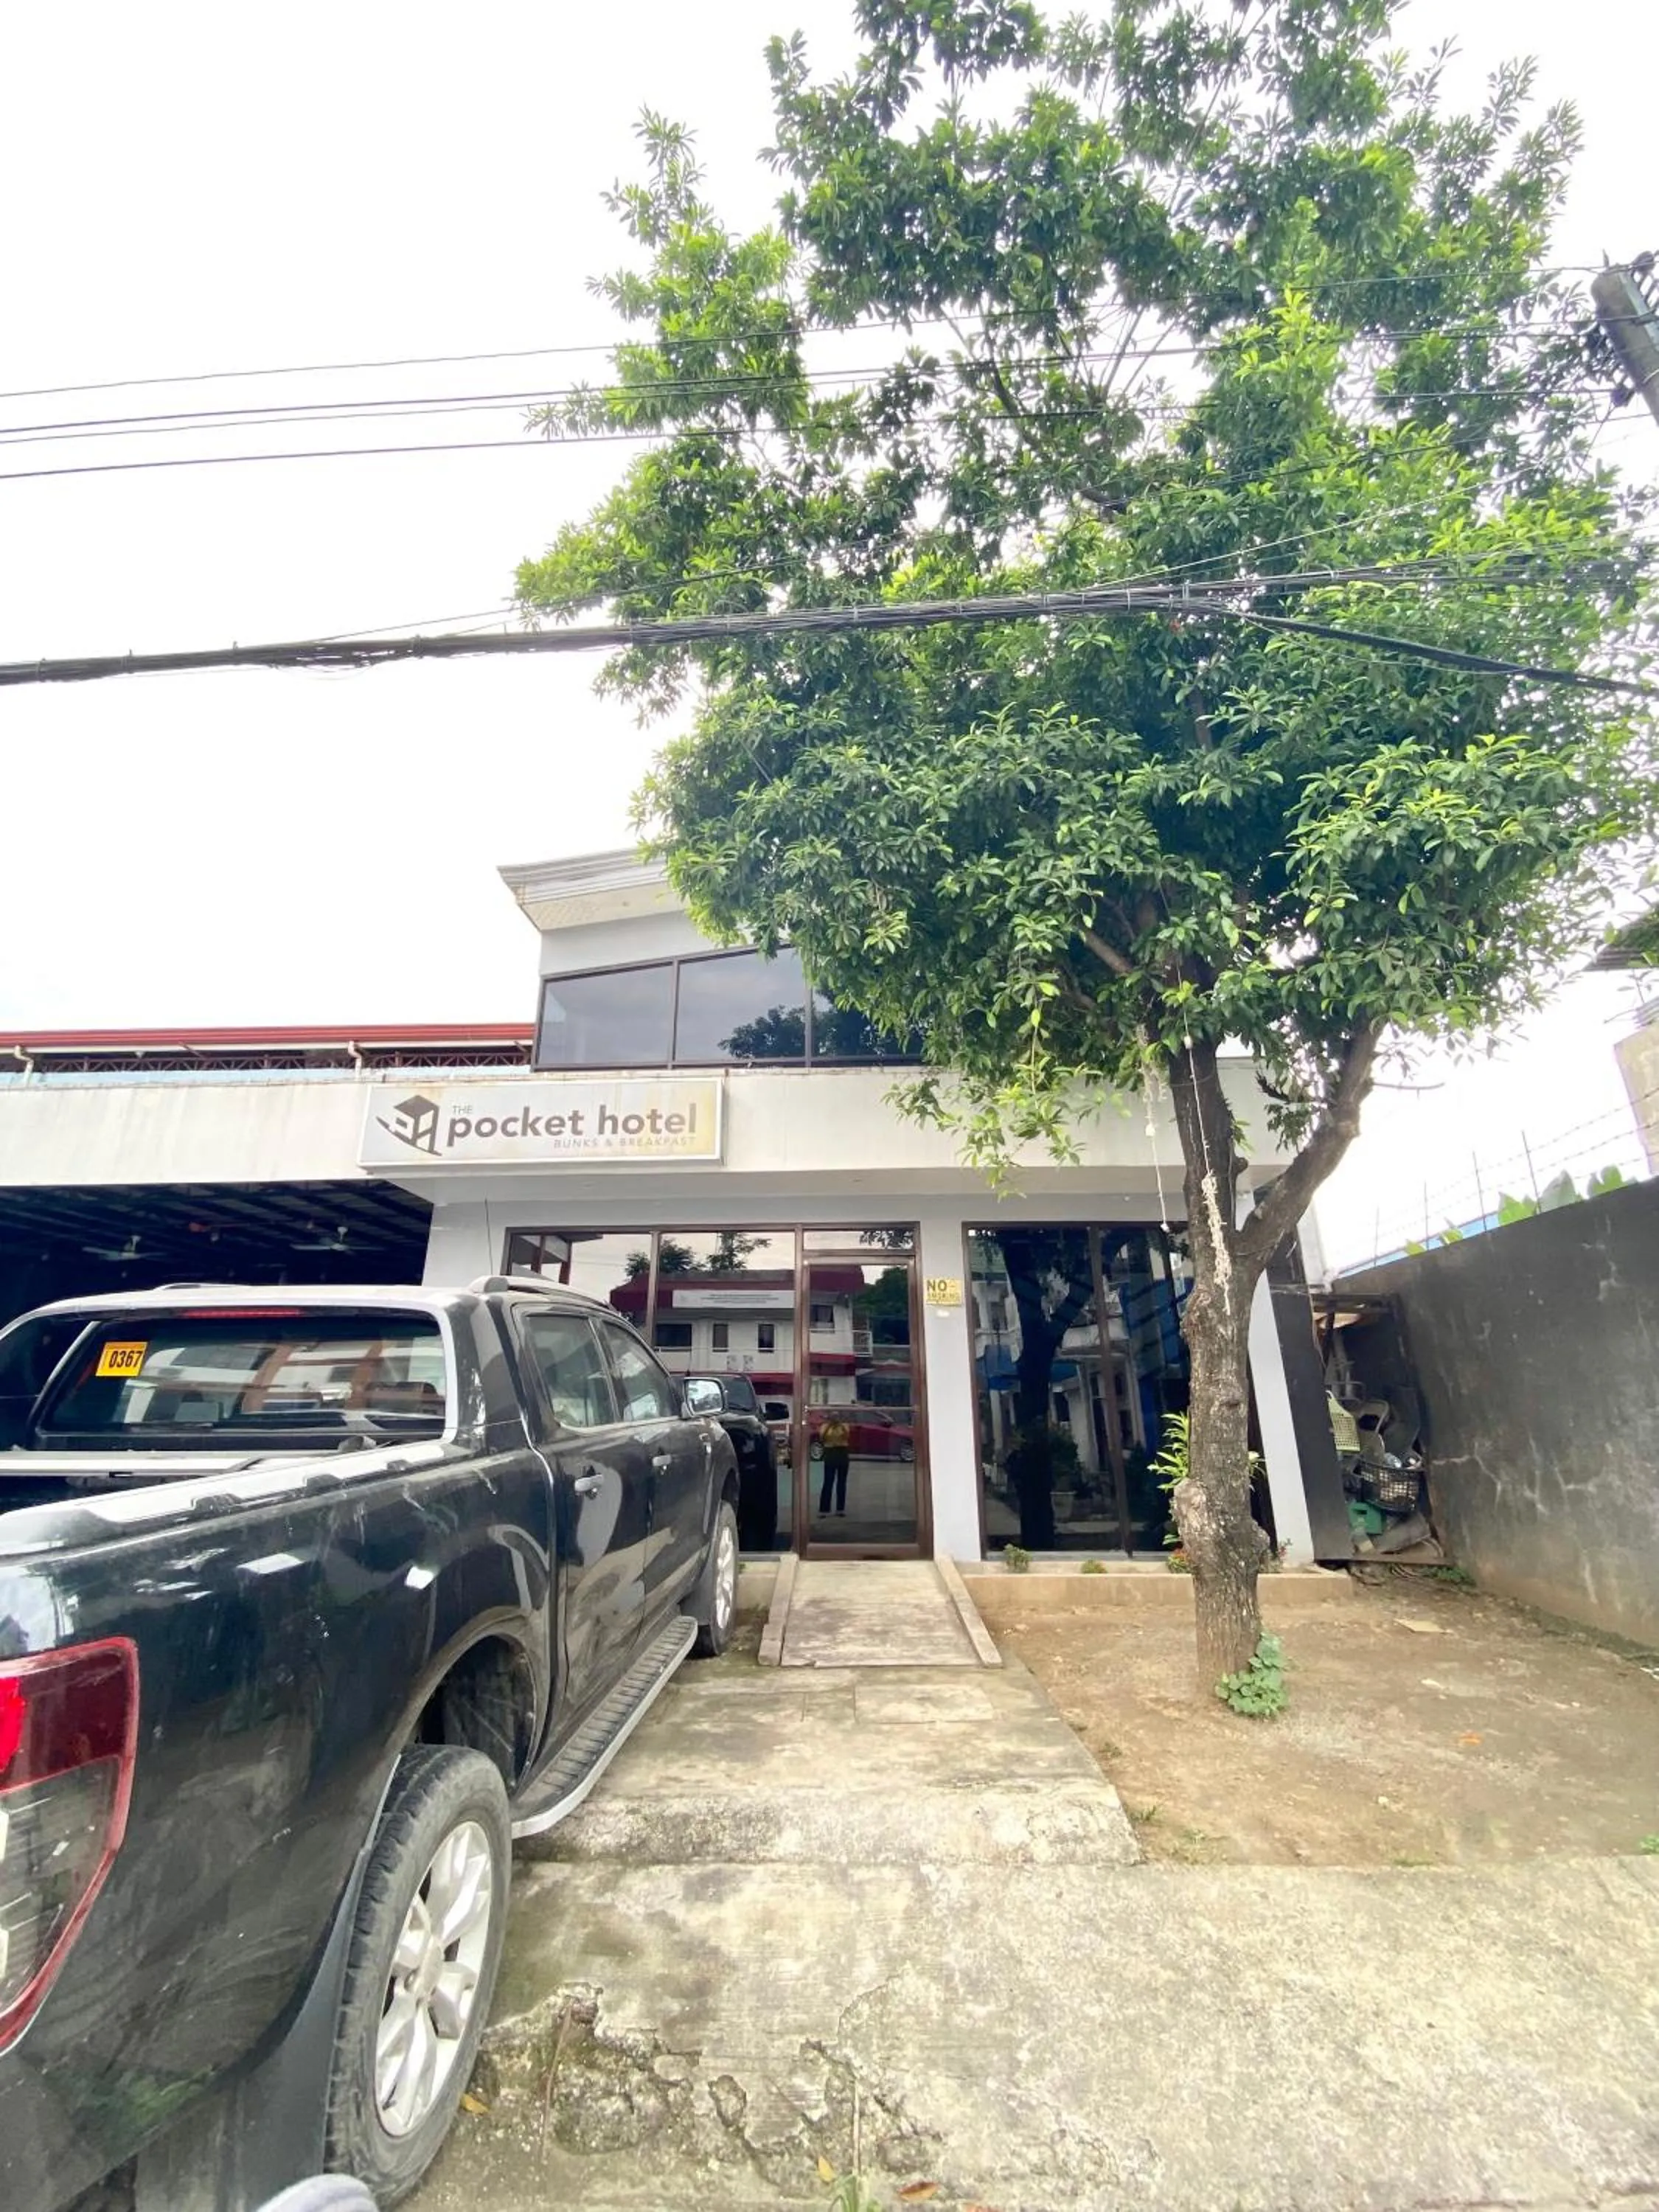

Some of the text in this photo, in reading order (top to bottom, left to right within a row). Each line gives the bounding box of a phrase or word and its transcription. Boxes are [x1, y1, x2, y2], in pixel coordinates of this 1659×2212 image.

[453, 1105, 473, 1114] THE
[447, 1103, 697, 1147] pocket hotel
[554, 1138, 598, 1148] BUNKS
[927, 1279, 947, 1292] NO
[108, 1350, 143, 1368] 0367
